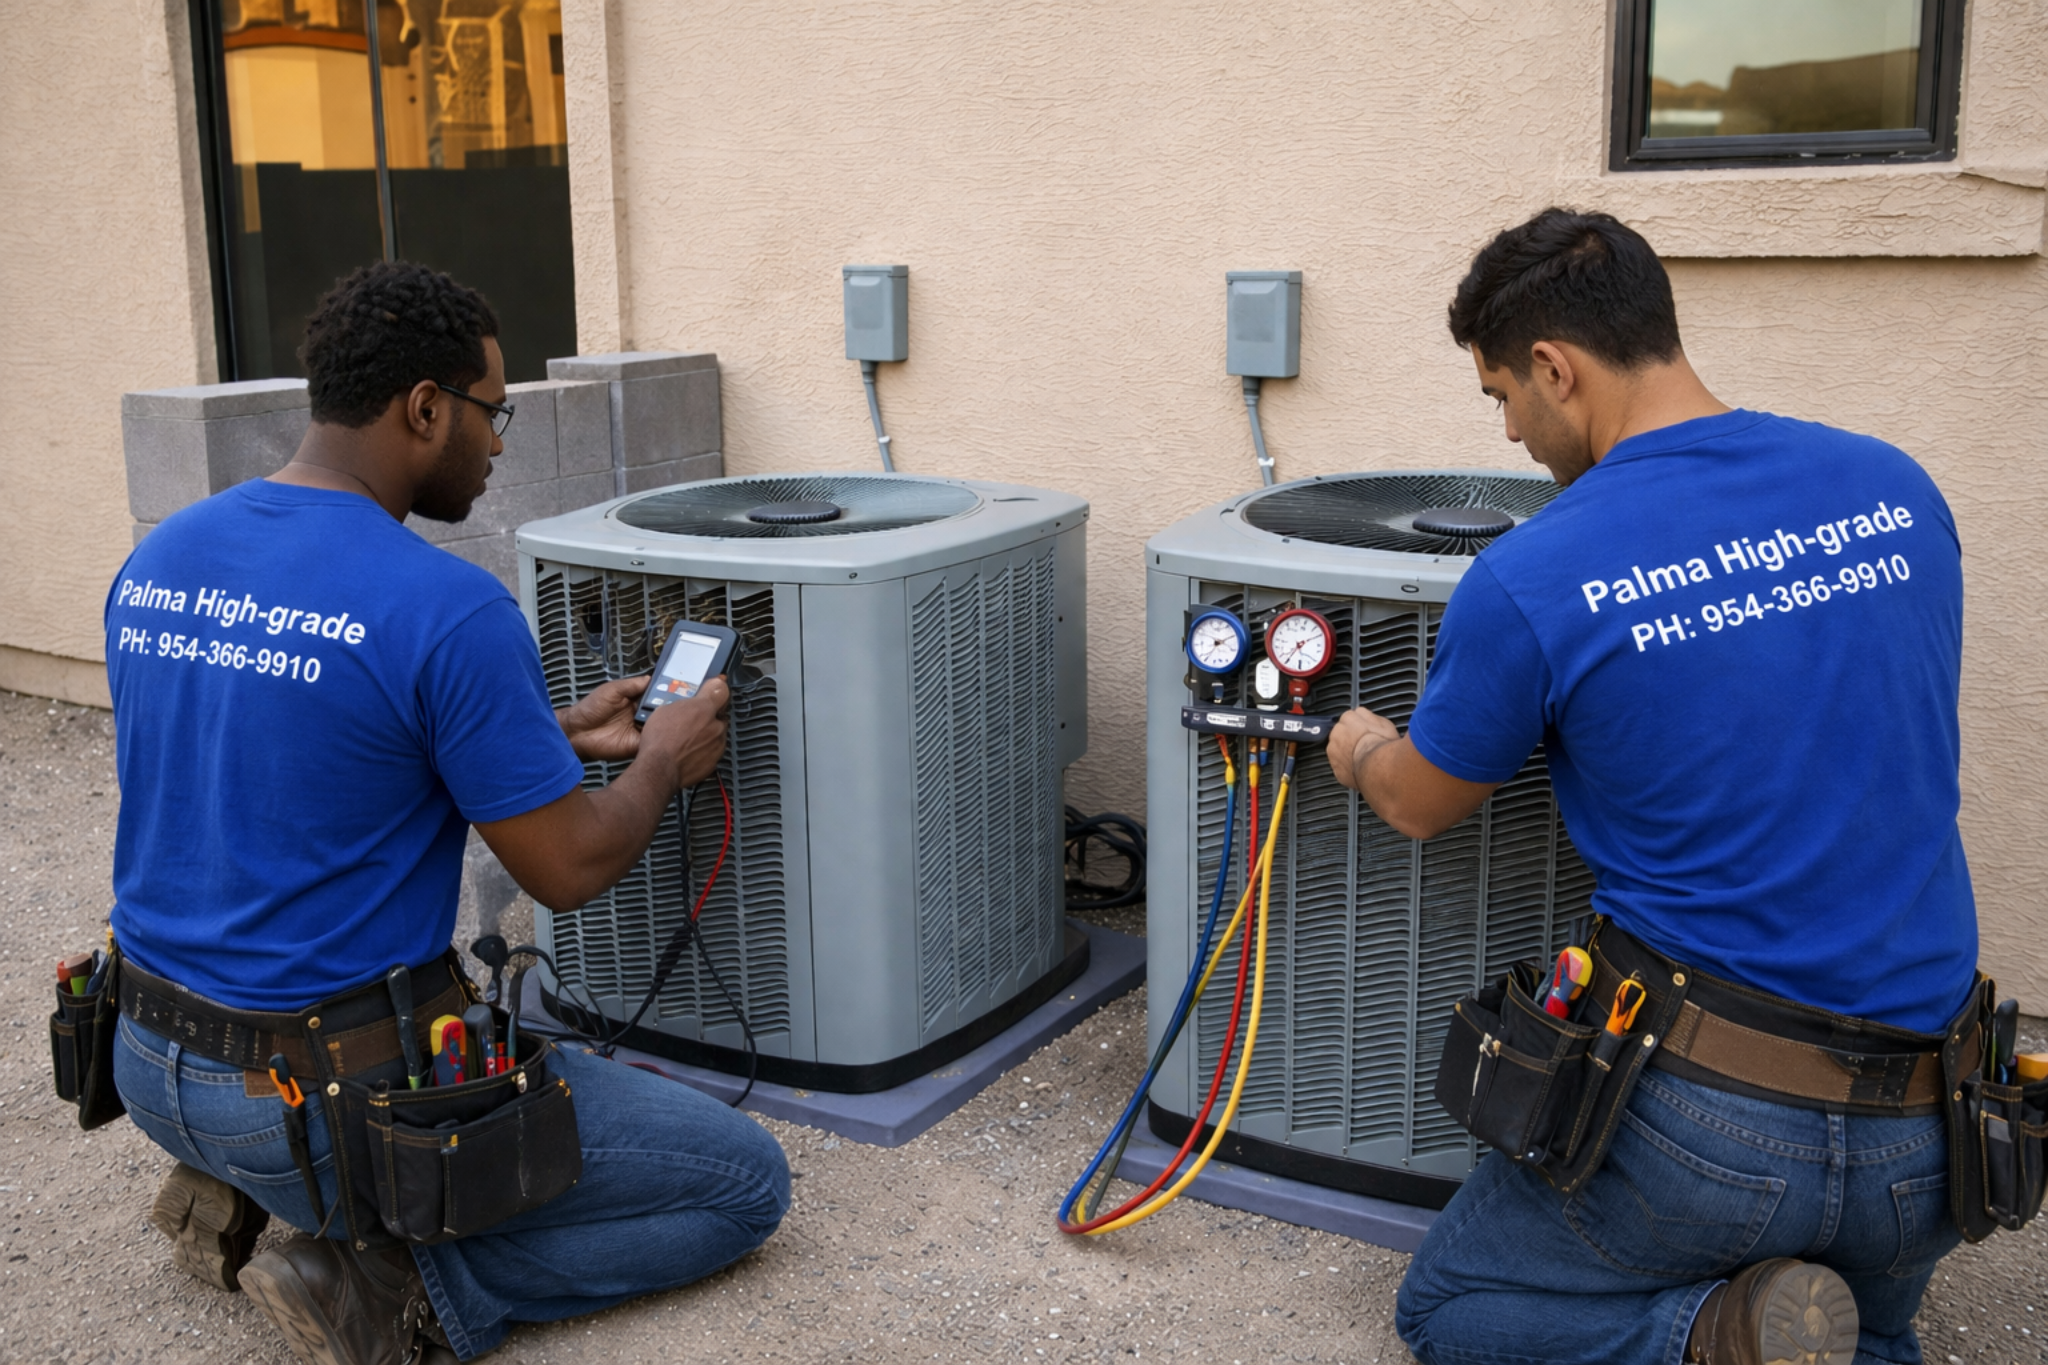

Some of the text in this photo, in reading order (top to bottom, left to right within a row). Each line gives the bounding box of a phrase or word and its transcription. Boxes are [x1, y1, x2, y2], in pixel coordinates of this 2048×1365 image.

[1581, 501, 1914, 614] Palma High-grade
[117, 579, 366, 645] Palma High-grade
[1631, 554, 1910, 653] PH: 954-366-9910
[118, 626, 321, 683] PH: 954-366-9910
